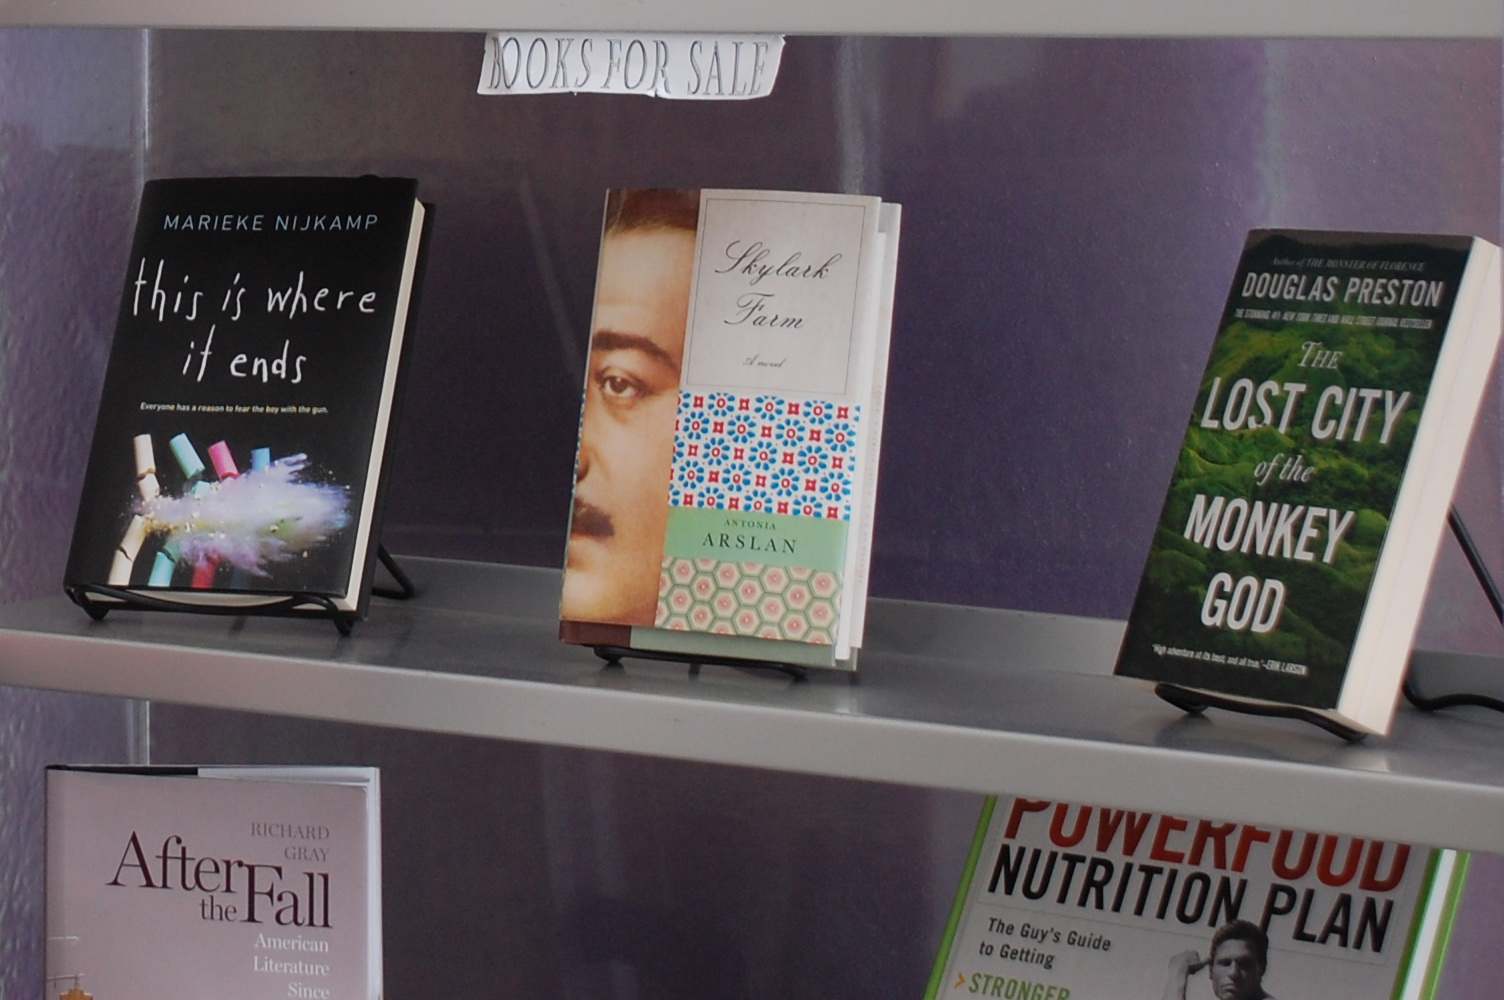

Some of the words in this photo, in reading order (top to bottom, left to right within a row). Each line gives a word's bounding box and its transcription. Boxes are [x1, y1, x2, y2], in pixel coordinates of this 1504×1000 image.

[488, 37, 593, 90] BOOKS
[600, 38, 671, 95] FOR
[687, 40, 769, 96] SALE
[163, 214, 264, 231] MARIEKE
[275, 214, 378, 231] NIJKAMP
[714, 239, 843, 286] Skylark
[1307, 257, 1325, 268] THE
[1379, 260, 1426, 273] FLORENCE
[133, 257, 203, 322] this
[222, 272, 246, 321] is
[267, 270, 376, 320] where
[1241, 271, 1339, 302] DOUGLAS
[1344, 276, 1444, 308] PRESTON
[724, 292, 804, 329] Farm
[182, 324, 216, 382] it
[230, 339, 307, 384] ends
[743, 354, 754, 367] A
[757, 357, 787, 368] novel
[1297, 341, 1343, 371] THE
[140, 401, 175, 412] Everyone
[176, 402, 190, 412] has
[198, 403, 224, 413] reason
[225, 404, 233, 413] to
[235, 403, 250, 414] fear
[252, 404, 264, 414] the
[265, 404, 279, 415] boy
[280, 404, 296, 414] with
[298, 405, 311, 414] the
[312, 406, 328, 415] gun.
[1200, 376, 1308, 435] LOST
[1311, 385, 1412, 445] CITY
[1253, 453, 1284, 486] of
[1279, 455, 1316, 483] the
[724, 518, 777, 531] ANTONIA
[1183, 493, 1357, 564] MONKEY
[702, 532, 797, 554] ARSLAN
[1200, 571, 1287, 634] GOD
[1167, 646, 1195, 659] adventure
[1227, 656, 1239, 665] and
[251, 822, 330, 840] RICHARD
[1004, 797, 1411, 893] POWERFOOD
[105, 830, 244, 894] After
[284, 846, 330, 862] GRAY
[199, 896, 237, 923] the
[240, 863, 334, 929] Fall
[987, 843, 1248, 928] NUTRITION
[1259, 882, 1394, 954] PLAN
[254, 932, 329, 953] American
[988, 918, 1014, 936] The
[1020, 922, 1061, 944] Guy's
[1067, 930, 1111, 951] Guide
[253, 956, 329, 976] Literature
[979, 941, 994, 956] to
[999, 943, 1055, 970] Getting
[288, 982, 330, 999] Since
[968, 972, 1070, 1000] STRONGER
